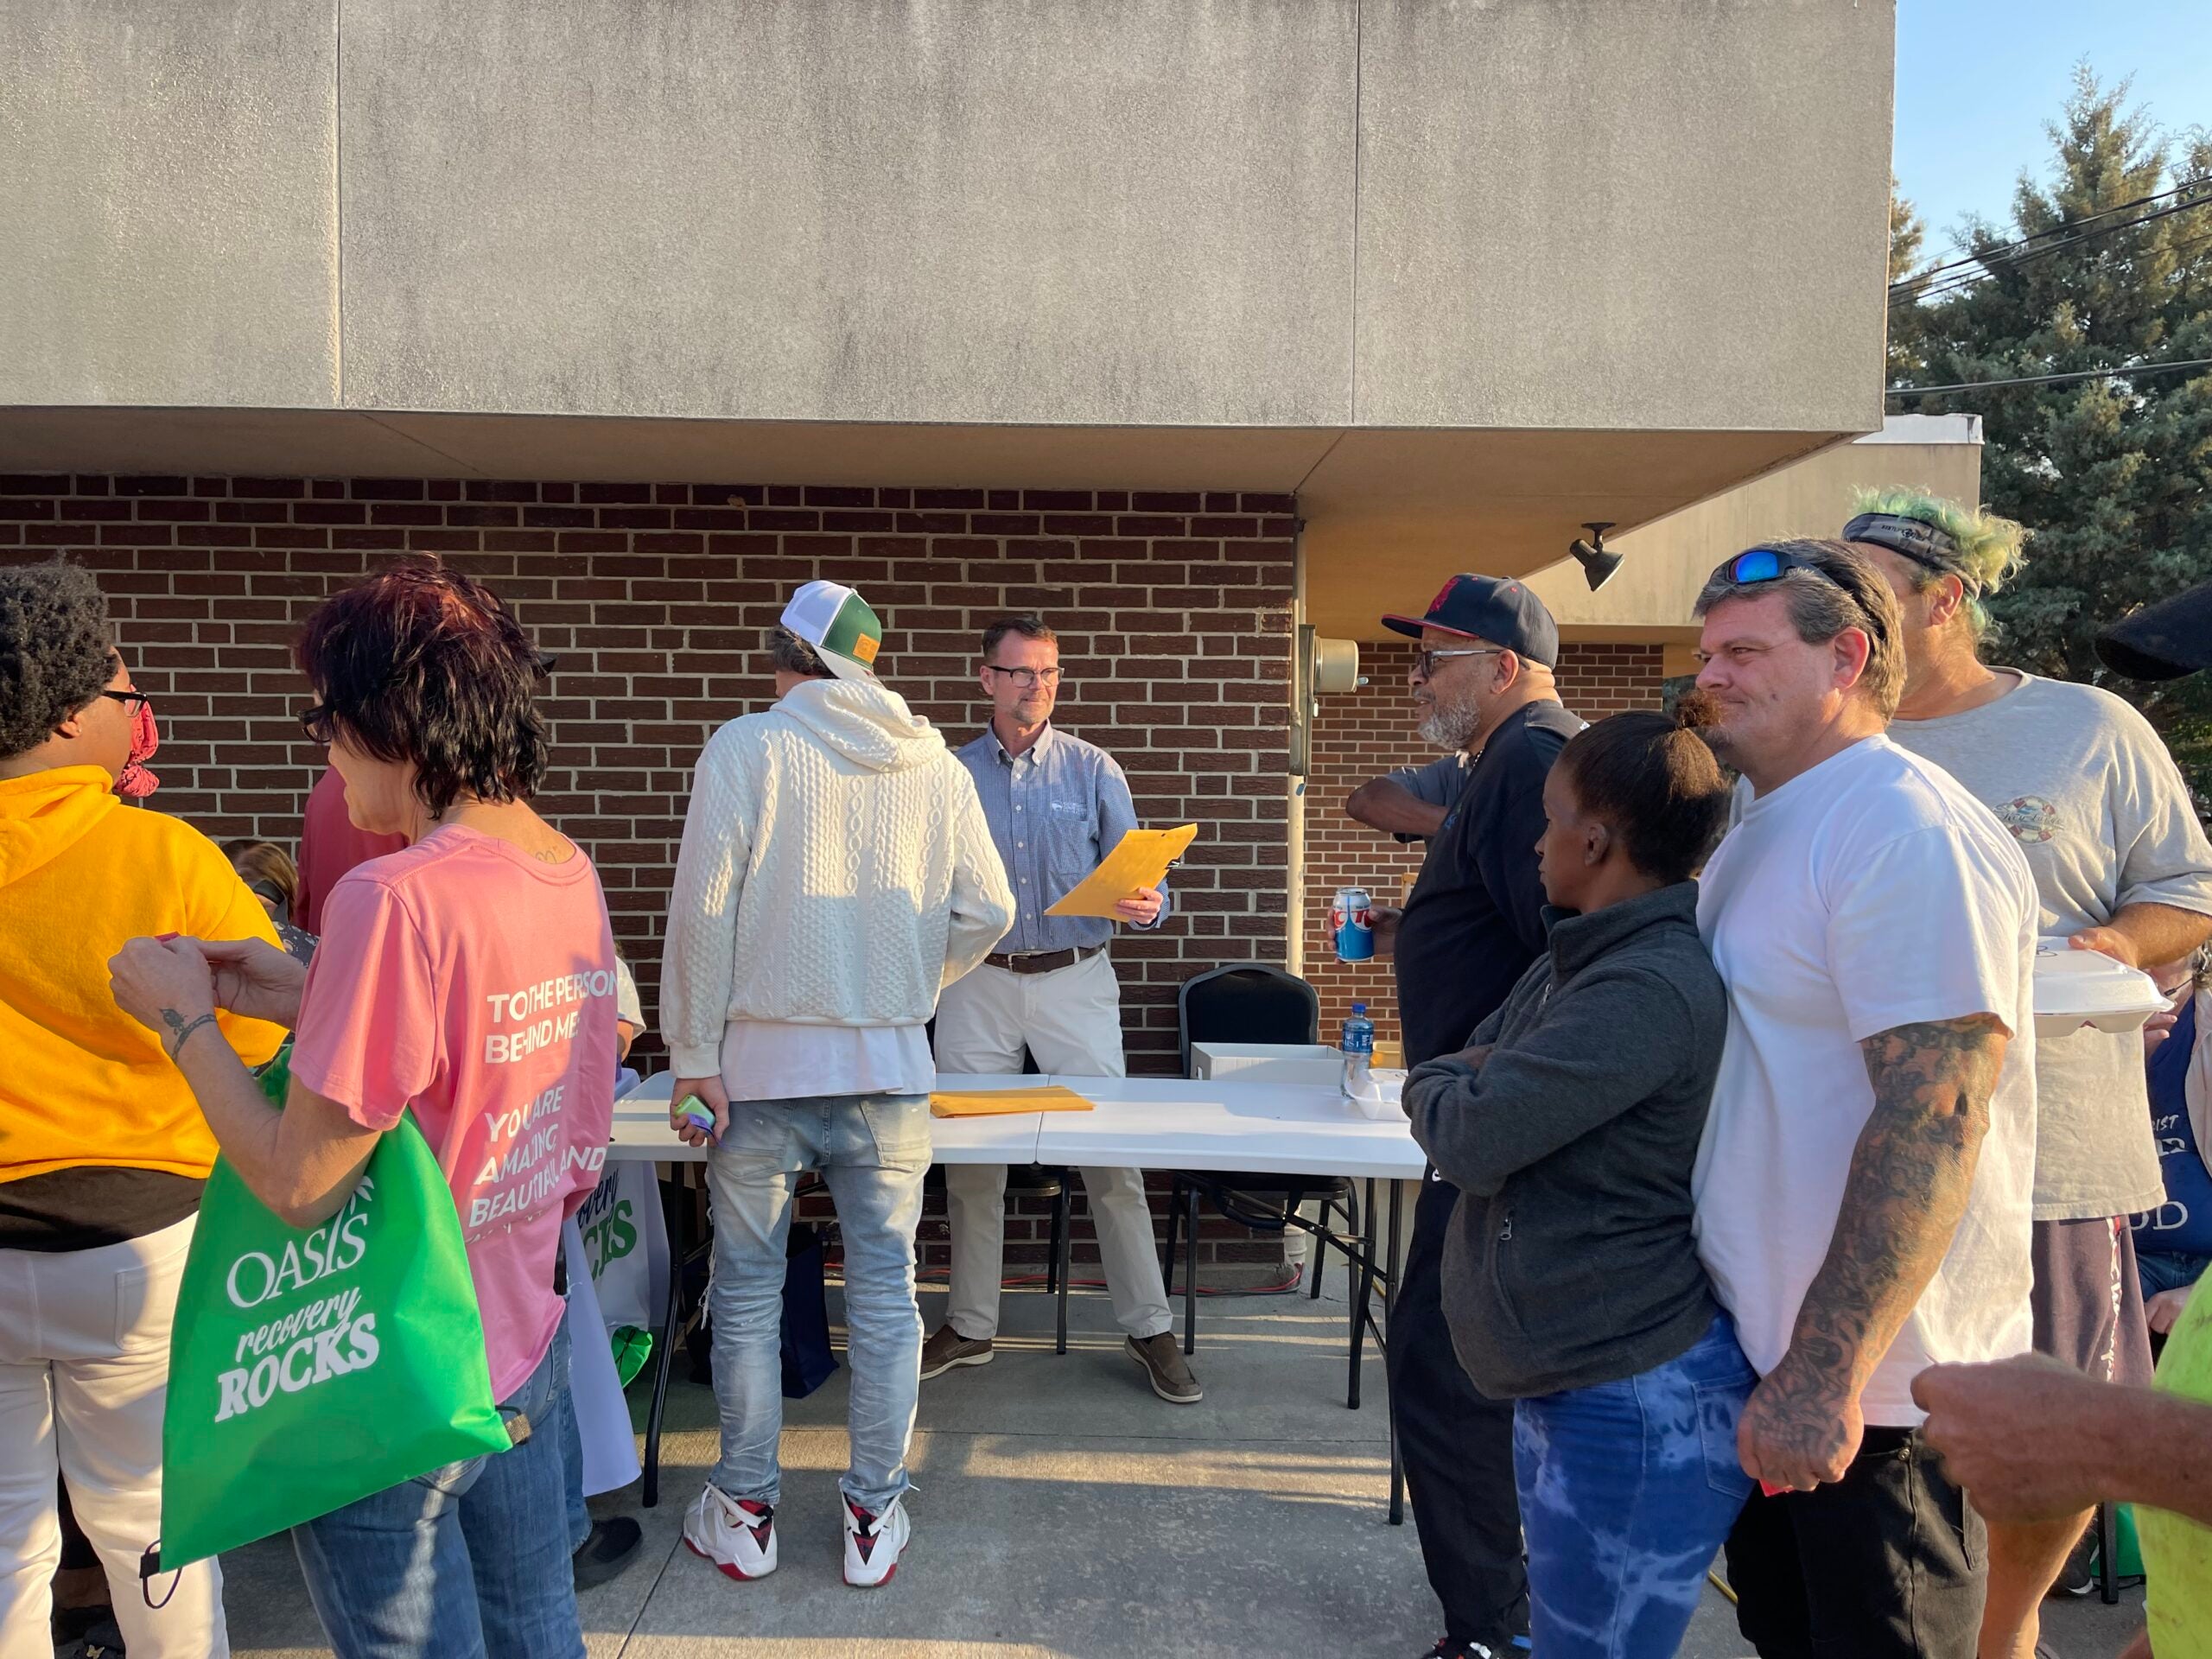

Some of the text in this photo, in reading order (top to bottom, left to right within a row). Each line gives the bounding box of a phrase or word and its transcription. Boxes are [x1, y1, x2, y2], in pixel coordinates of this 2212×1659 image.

[486, 990, 528, 1024] TO
[528, 980, 554, 1014] THE
[532, 1085, 565, 1123] ARE
[559, 1145, 607, 1177] AND
[226, 1212, 369, 1309] OASIS
[582, 1199, 638, 1281] CKS
[235, 1286, 362, 1363] recovery
[215, 1313, 380, 1424] ROCKS
